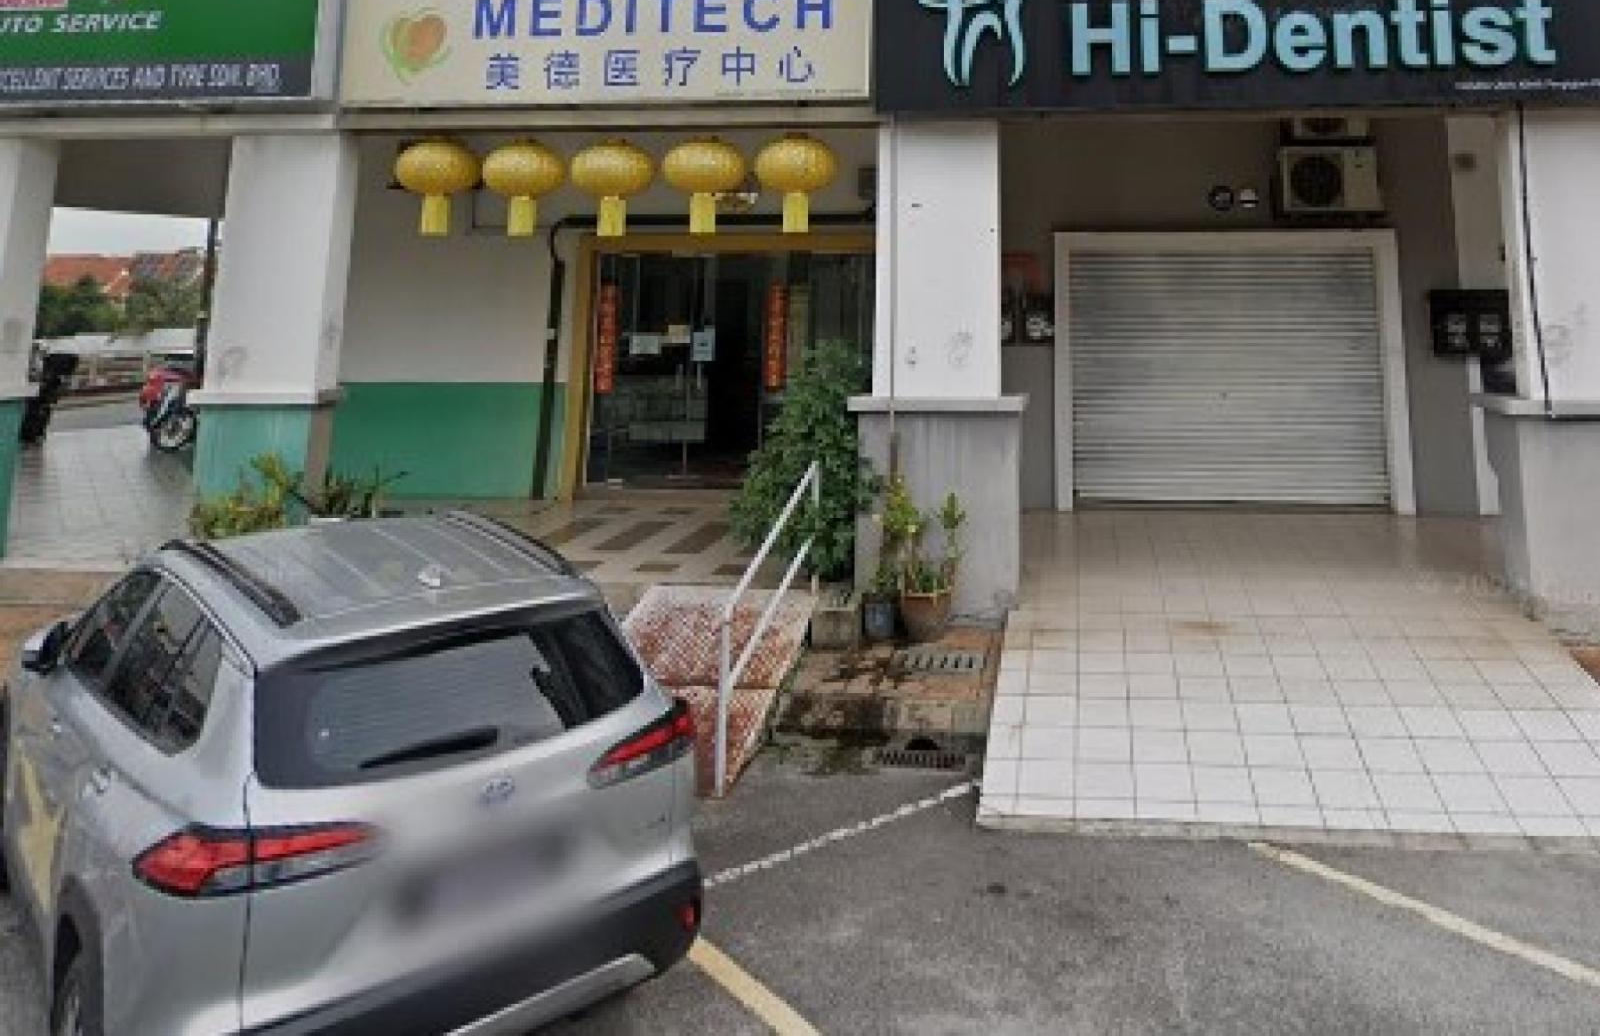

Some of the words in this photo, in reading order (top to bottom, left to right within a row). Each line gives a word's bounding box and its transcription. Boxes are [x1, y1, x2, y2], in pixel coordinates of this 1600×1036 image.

[0, 15, 43, 33] UTO
[51, 11, 163, 33] SERVICE
[0, 66, 61, 91] CELLENT
[62, 66, 130, 90] SERVICES
[132, 65, 166, 89] AND
[484, 45, 816, 91] 美德医疗中心
